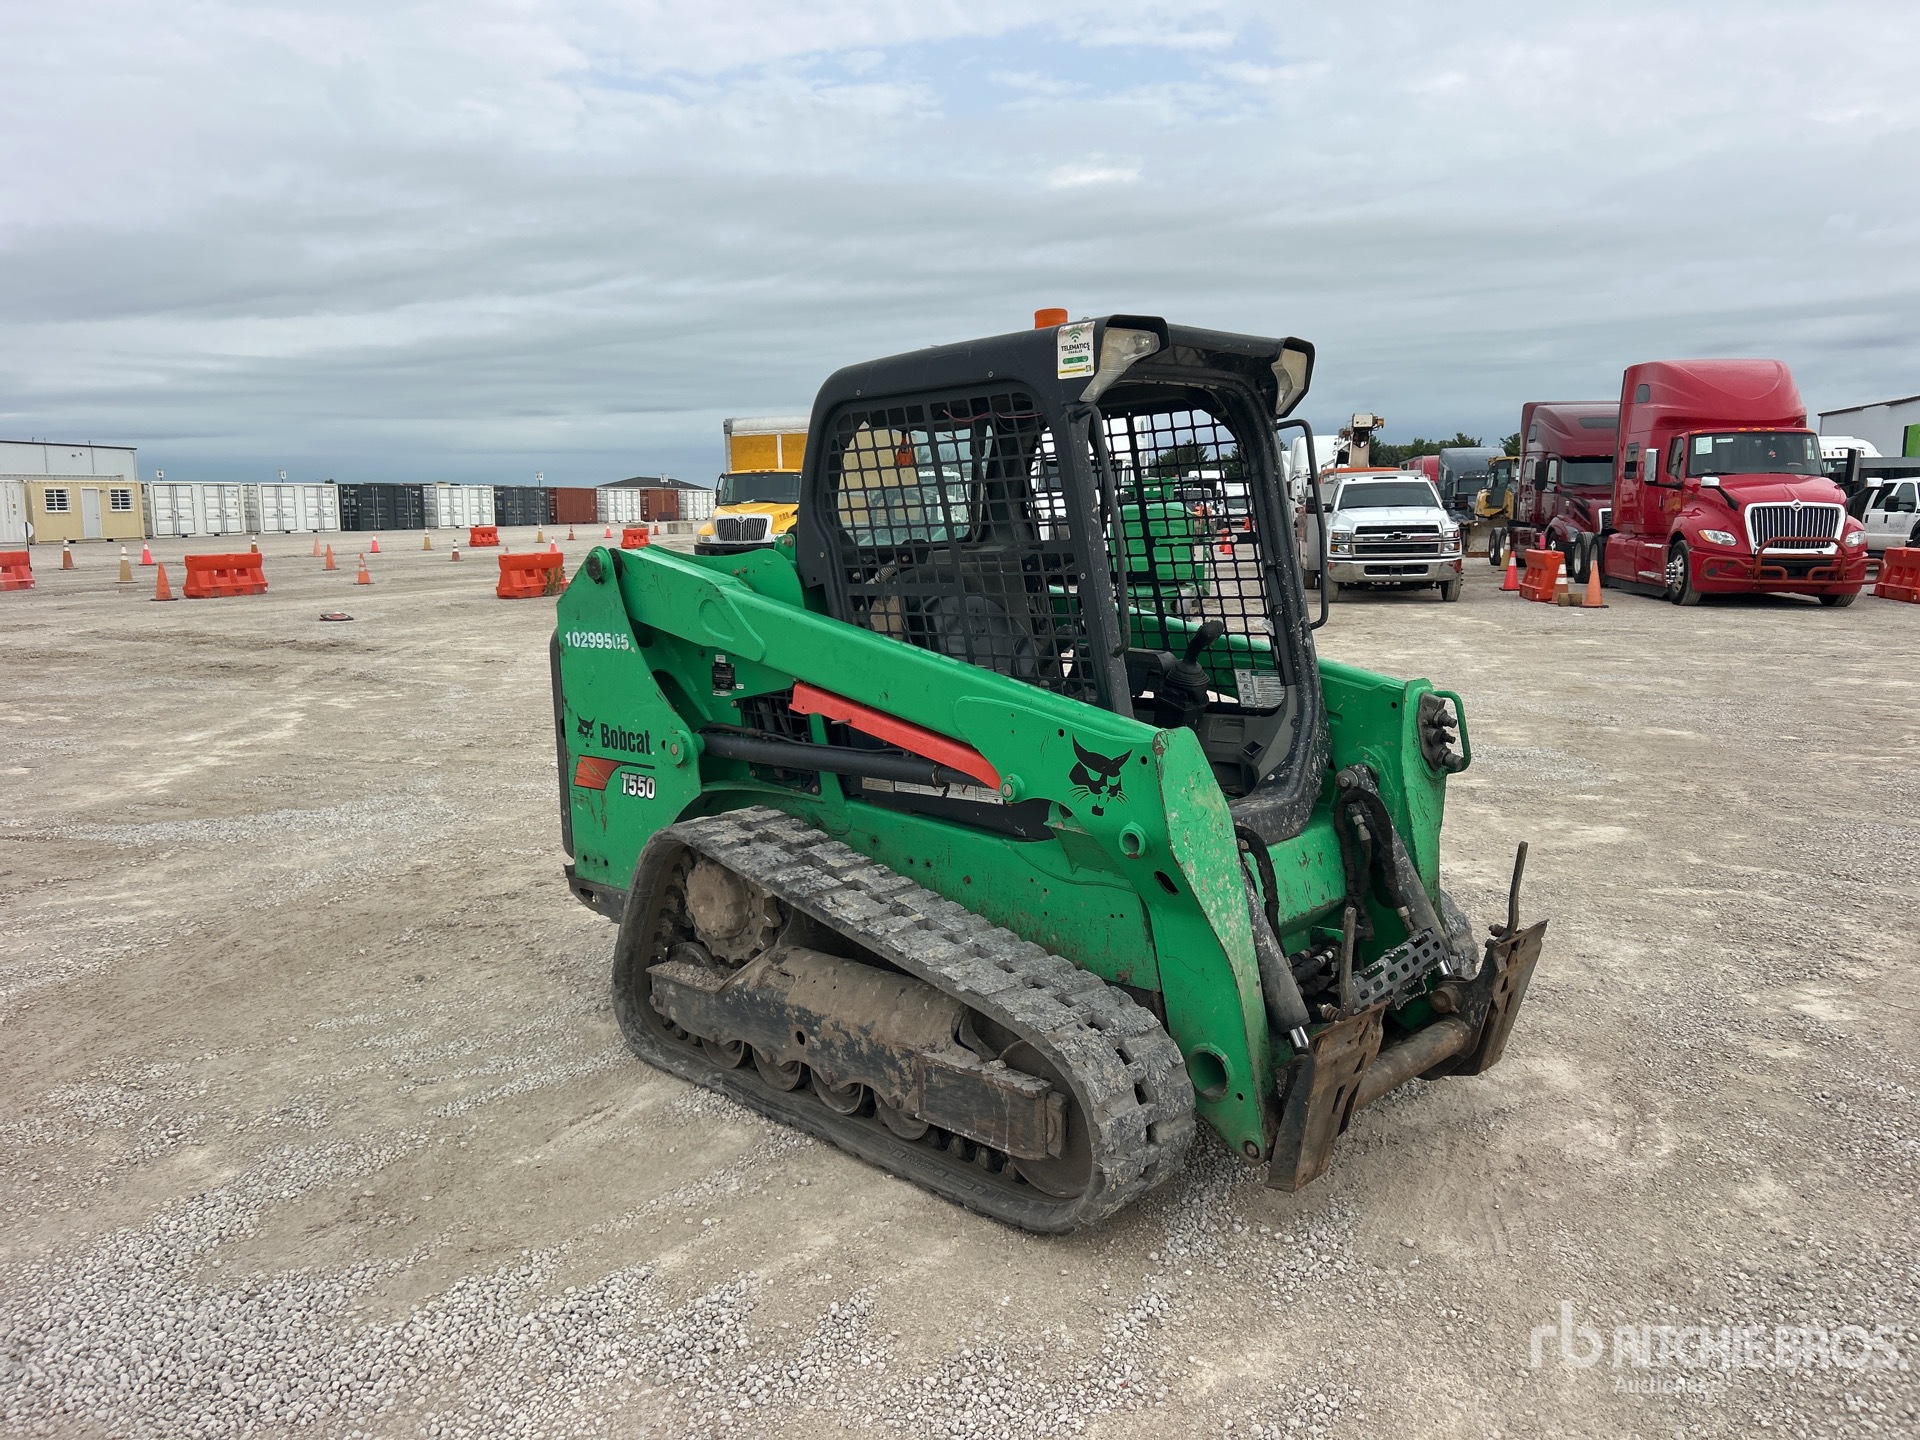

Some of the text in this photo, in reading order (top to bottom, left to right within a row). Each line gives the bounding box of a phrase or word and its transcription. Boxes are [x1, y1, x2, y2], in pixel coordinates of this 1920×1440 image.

[1061, 342, 1090, 352] TELEMATICS
[565, 631, 629, 650] 10299505
[600, 722, 651, 755] Bobcat
[620, 771, 656, 800] T550
